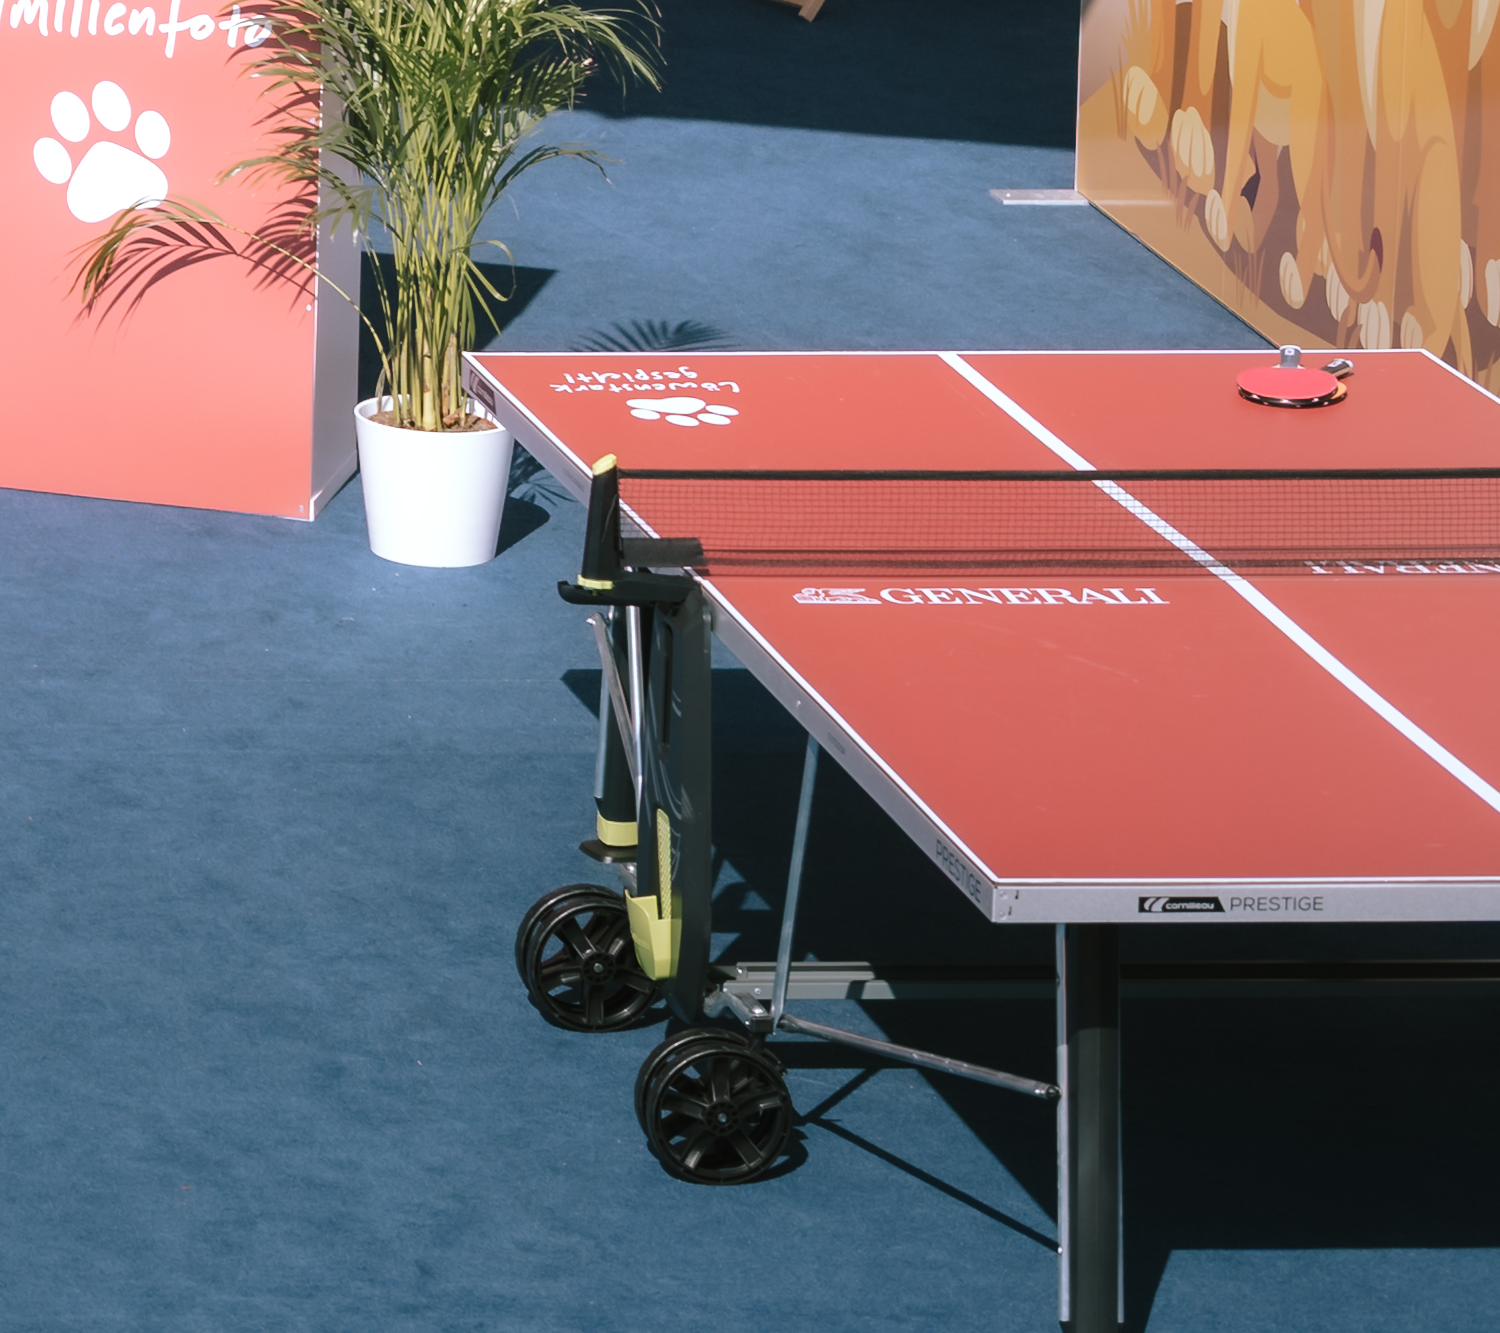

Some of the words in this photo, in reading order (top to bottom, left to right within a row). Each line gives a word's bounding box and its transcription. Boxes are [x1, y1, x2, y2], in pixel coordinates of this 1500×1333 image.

[879, 587, 1171, 605] GENERALI
[934, 837, 983, 904] PRESTIGE
[1229, 896, 1325, 913] PRESTIGE
